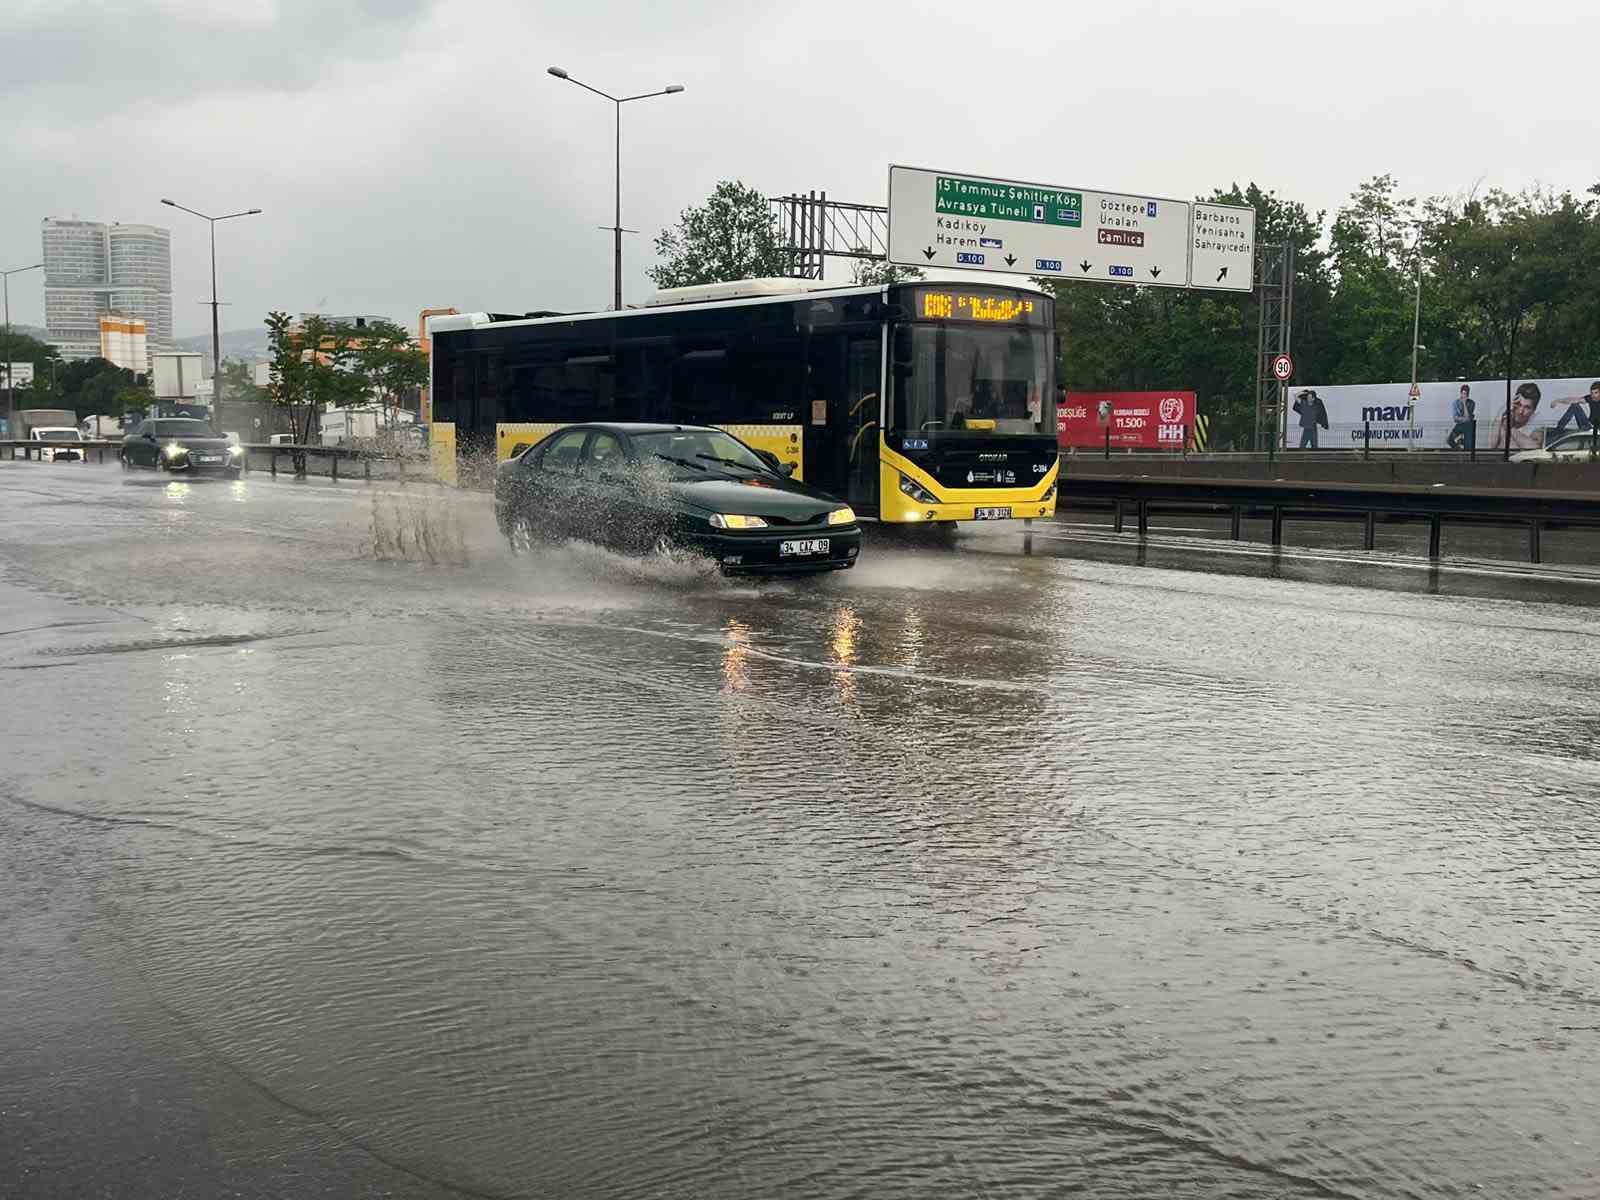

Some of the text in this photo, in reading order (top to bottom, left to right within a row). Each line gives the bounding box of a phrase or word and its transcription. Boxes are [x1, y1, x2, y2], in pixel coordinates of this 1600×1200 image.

[938, 179, 951, 191] 15
[954, 181, 1006, 198] Temmuz
[937, 196, 986, 215] Avrasya
[1196, 210, 1240, 224] Barbaros
[936, 233, 977, 247] Harem
[1278, 361, 1289, 374] 90
[784, 543, 794, 552] 34
[818, 540, 829, 550] 09
